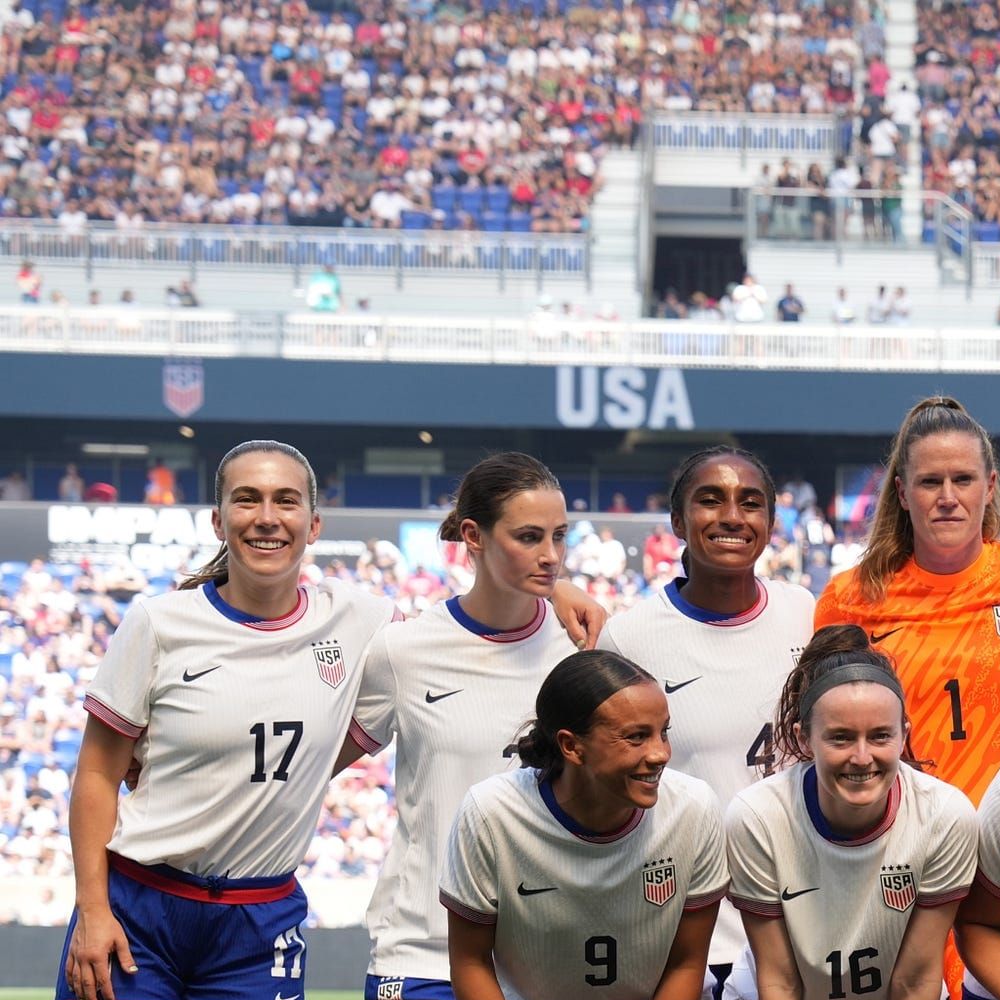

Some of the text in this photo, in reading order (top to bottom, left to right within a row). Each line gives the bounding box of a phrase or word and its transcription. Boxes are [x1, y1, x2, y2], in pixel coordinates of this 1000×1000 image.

[557, 366, 694, 429] USA
[317, 650, 340, 664] USA
[944, 679, 966, 740] 1
[250, 721, 303, 782] 17
[746, 722, 776, 775] 4
[646, 867, 672, 884] USA
[884, 874, 911, 891] USA
[271, 925, 305, 978] 17
[585, 935, 617, 986] 9
[826, 947, 882, 999] 16
[379, 984, 401, 999] USA
